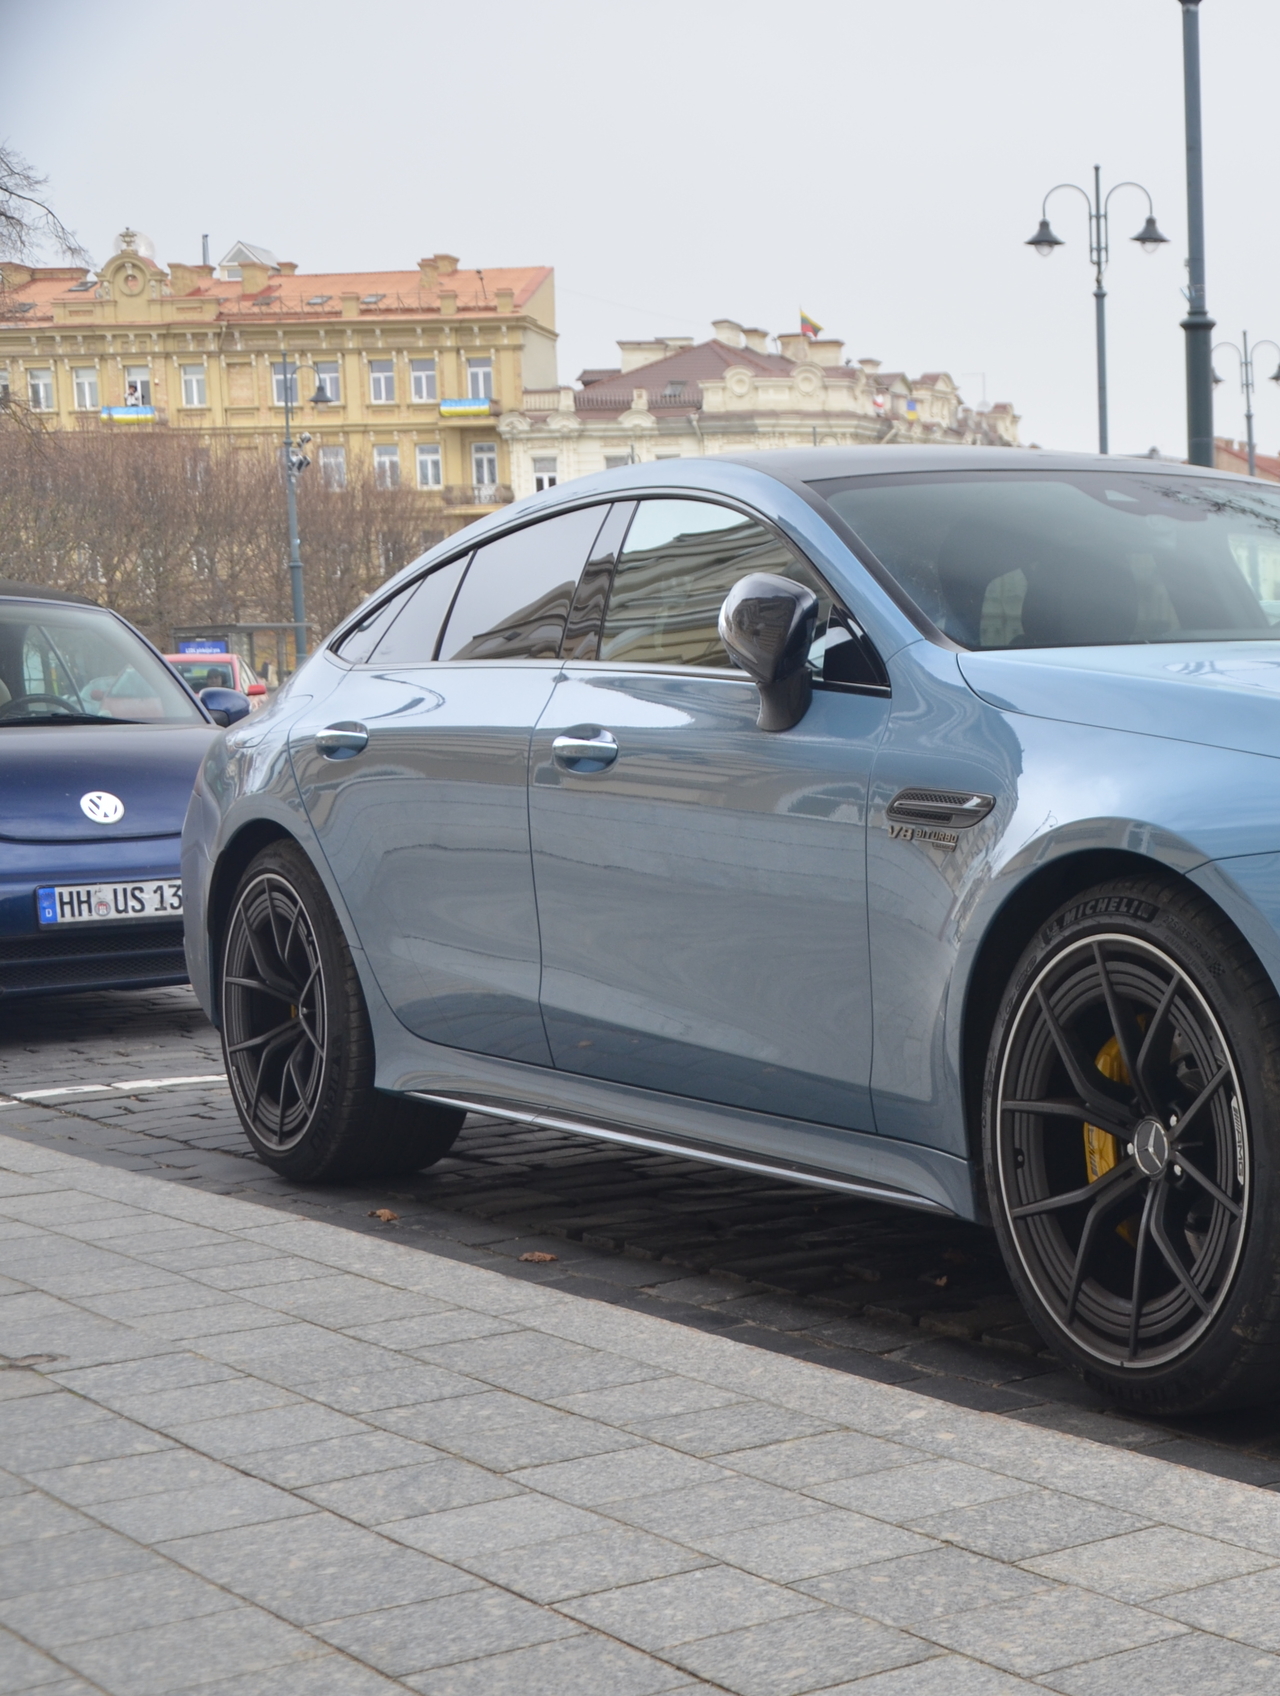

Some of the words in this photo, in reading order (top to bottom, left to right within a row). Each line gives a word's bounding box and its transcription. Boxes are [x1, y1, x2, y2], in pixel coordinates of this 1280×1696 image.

[889, 825, 914, 841] V8
[915, 829, 959, 843] BITURBO
[45, 908, 54, 918] D
[58, 889, 93, 918] HH
[113, 886, 146, 914] US
[1063, 897, 1154, 927] MICHELIN
